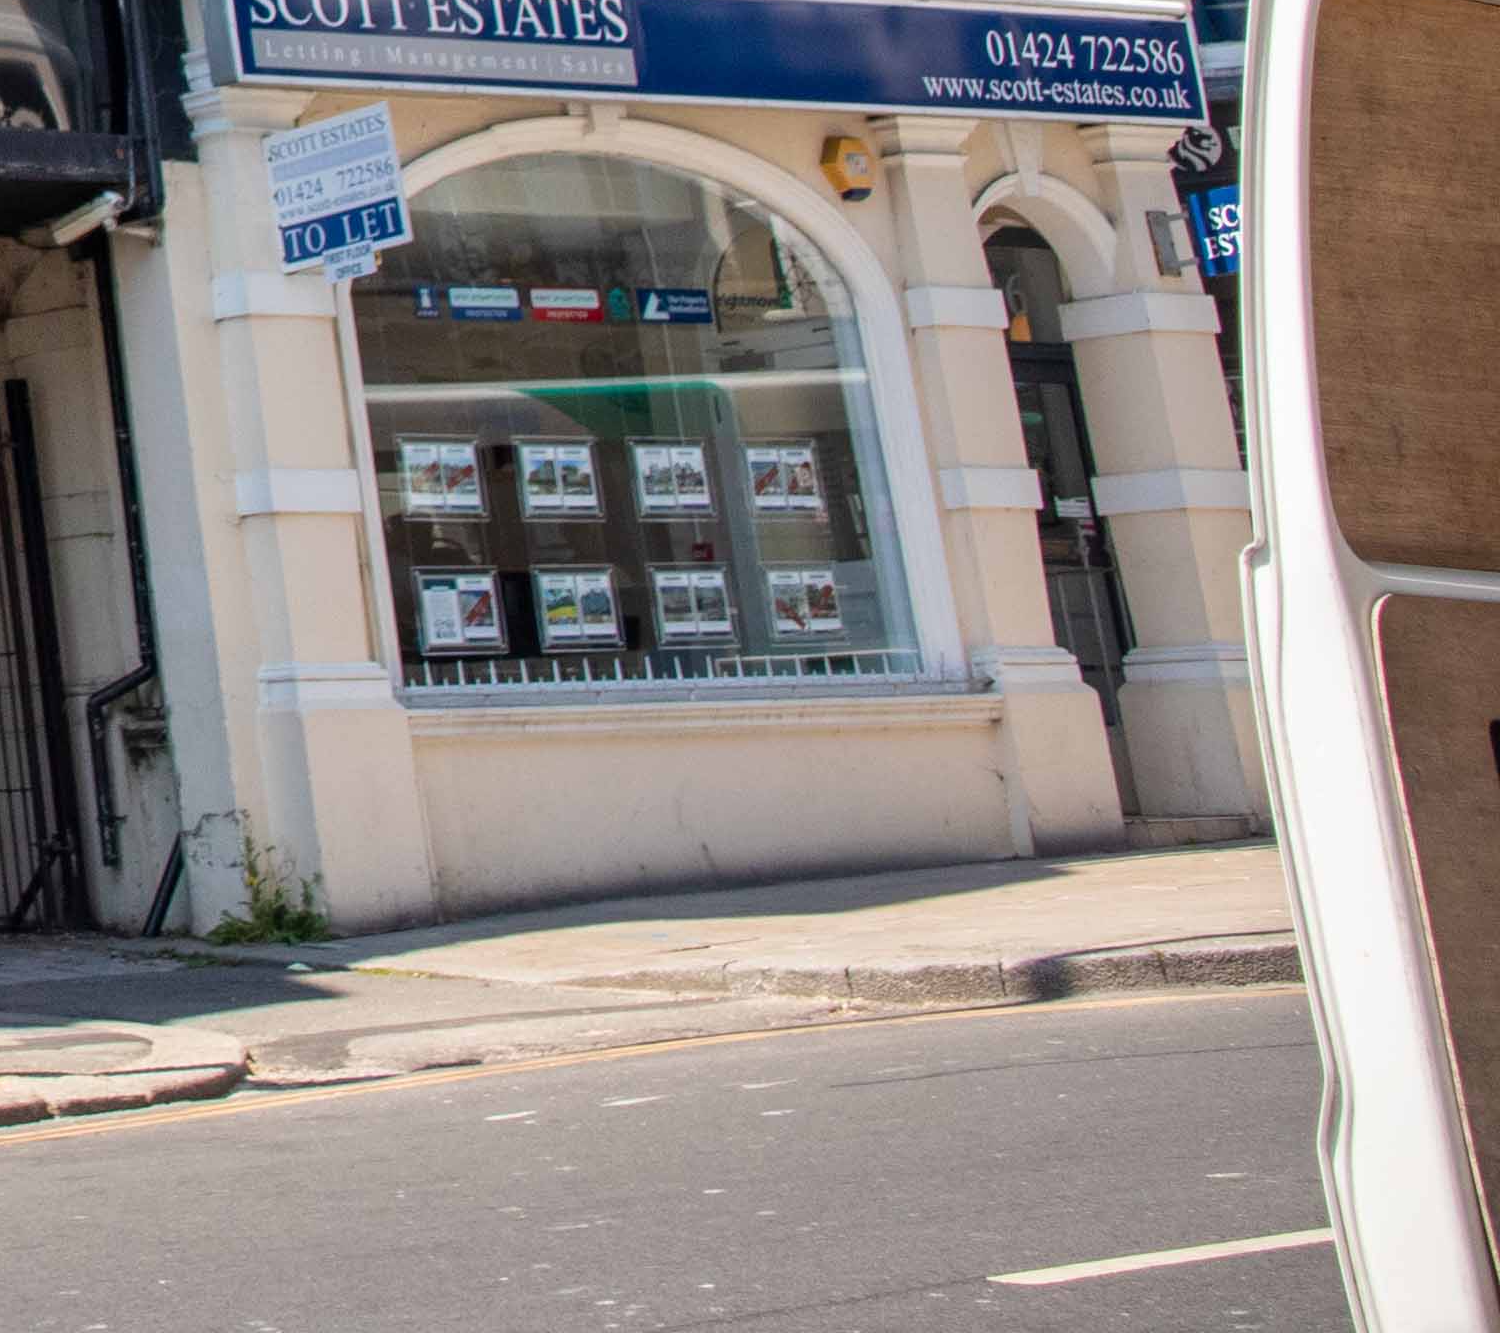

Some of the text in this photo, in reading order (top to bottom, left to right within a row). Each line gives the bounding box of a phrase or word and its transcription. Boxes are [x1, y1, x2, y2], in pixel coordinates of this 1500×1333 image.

[265, 39, 625, 77] Letting Management Sales
[985, 29, 1185, 76] 01424 722586
[922, 75, 1192, 110] www.scott-estates.co.uk
[270, 113, 387, 160] SCOTT ESTATES
[274, 156, 395, 206] 01424 722586
[284, 202, 398, 258] TO LET
[1208, 203, 1243, 230] SC
